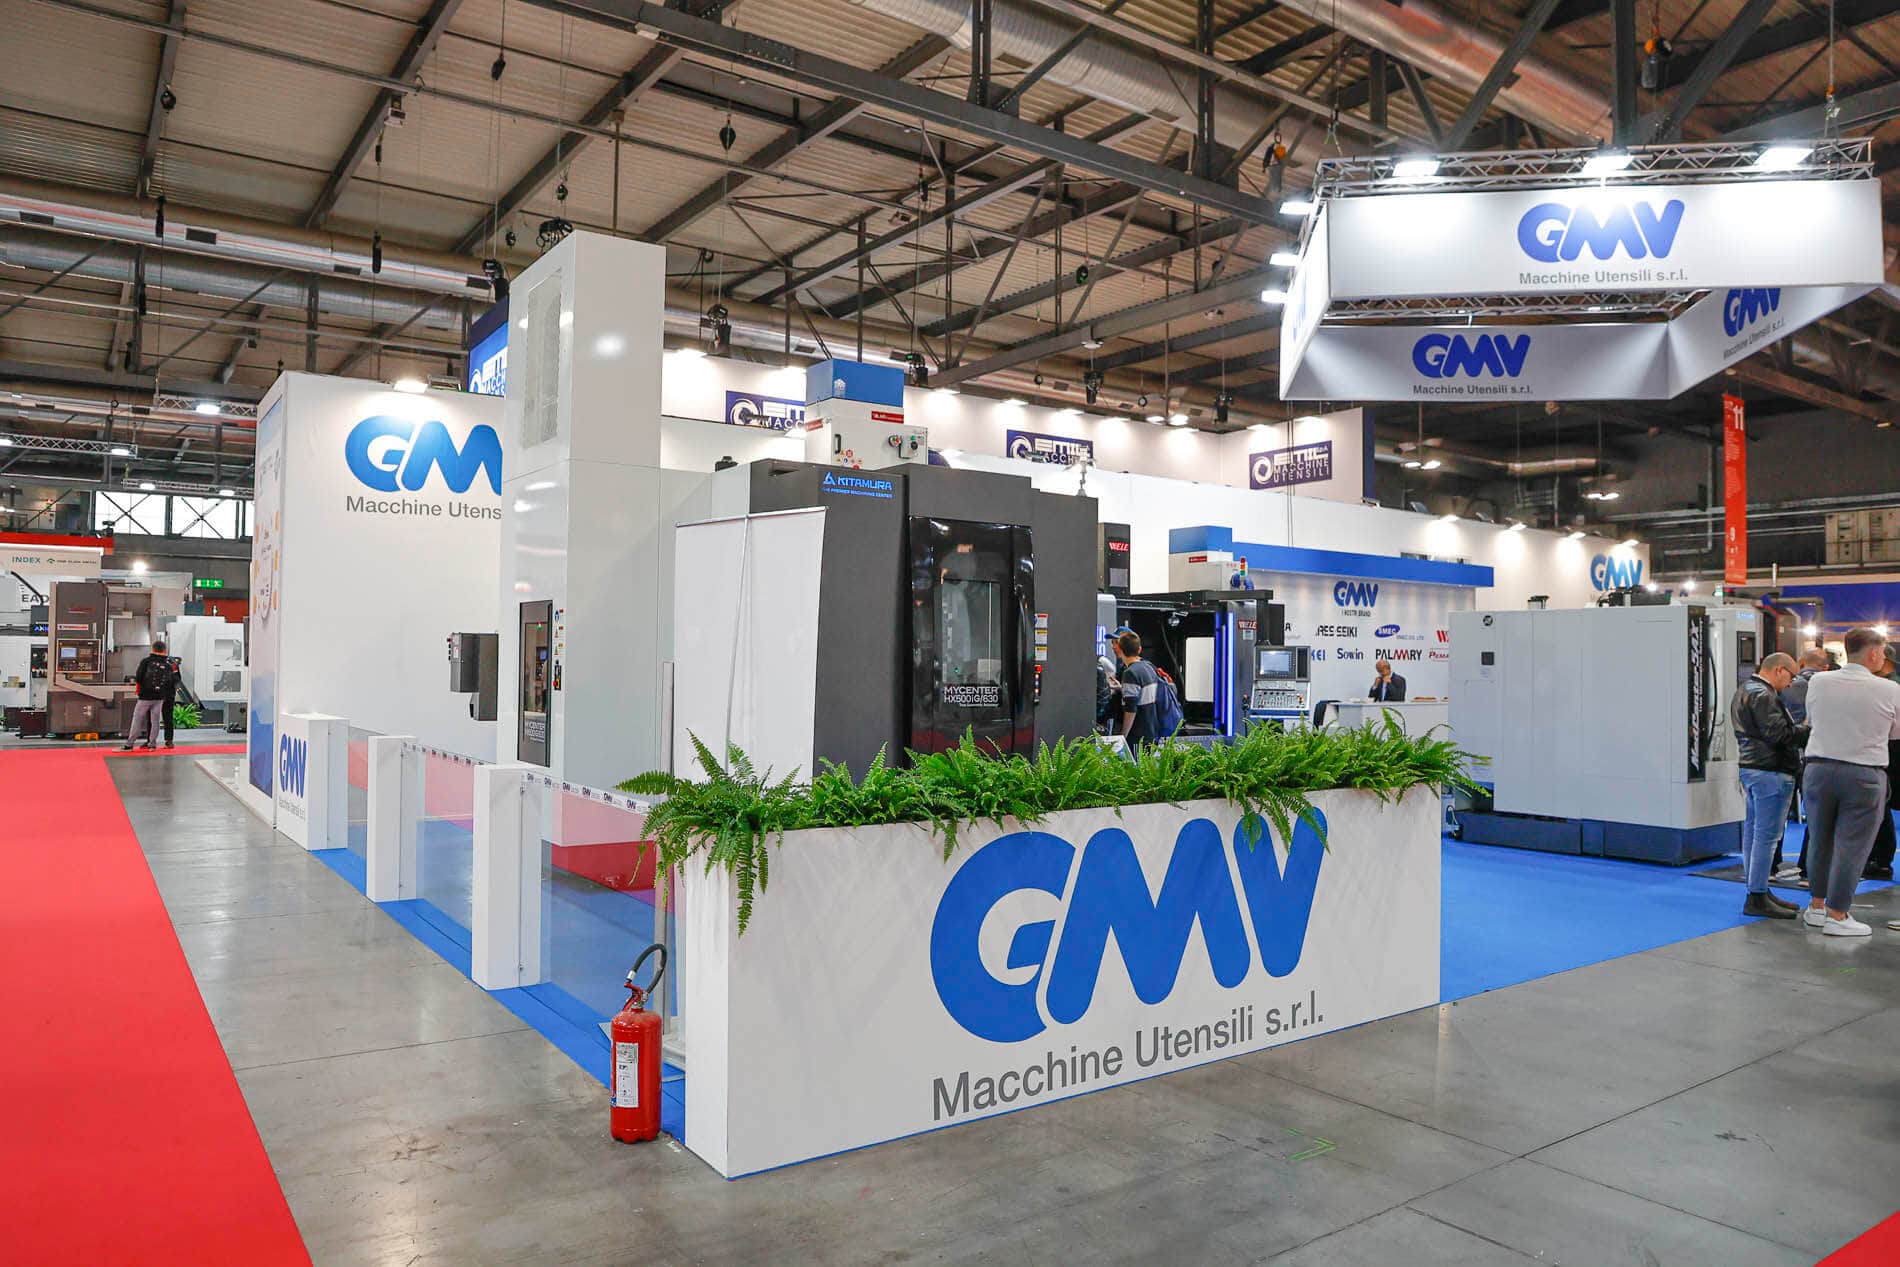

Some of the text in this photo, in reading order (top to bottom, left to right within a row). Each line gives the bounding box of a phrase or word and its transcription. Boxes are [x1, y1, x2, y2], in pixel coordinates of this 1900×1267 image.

[1517, 200, 1685, 263] GMV
[1519, 268, 1688, 284] Macchine Utensili s.r.l.
[1412, 333, 1531, 378] GMV
[1413, 384, 1533, 394] Macchine Utensili s.r.l.
[837, 476, 893, 490] KITAMURA
[1273, 466, 1329, 484] UTENSILI
[346, 495, 502, 520] Macchine Utens
[11, 556, 41, 564] INDEX
[1333, 580, 1379, 608] GMV
[1337, 647, 1364, 660] Sowin
[944, 686, 999, 694] MYCENTER
[279, 733, 307, 798] GMV
[930, 806, 1328, 1043] GMV
[932, 990, 1323, 1121] Macchine Utensili s.r.l.
